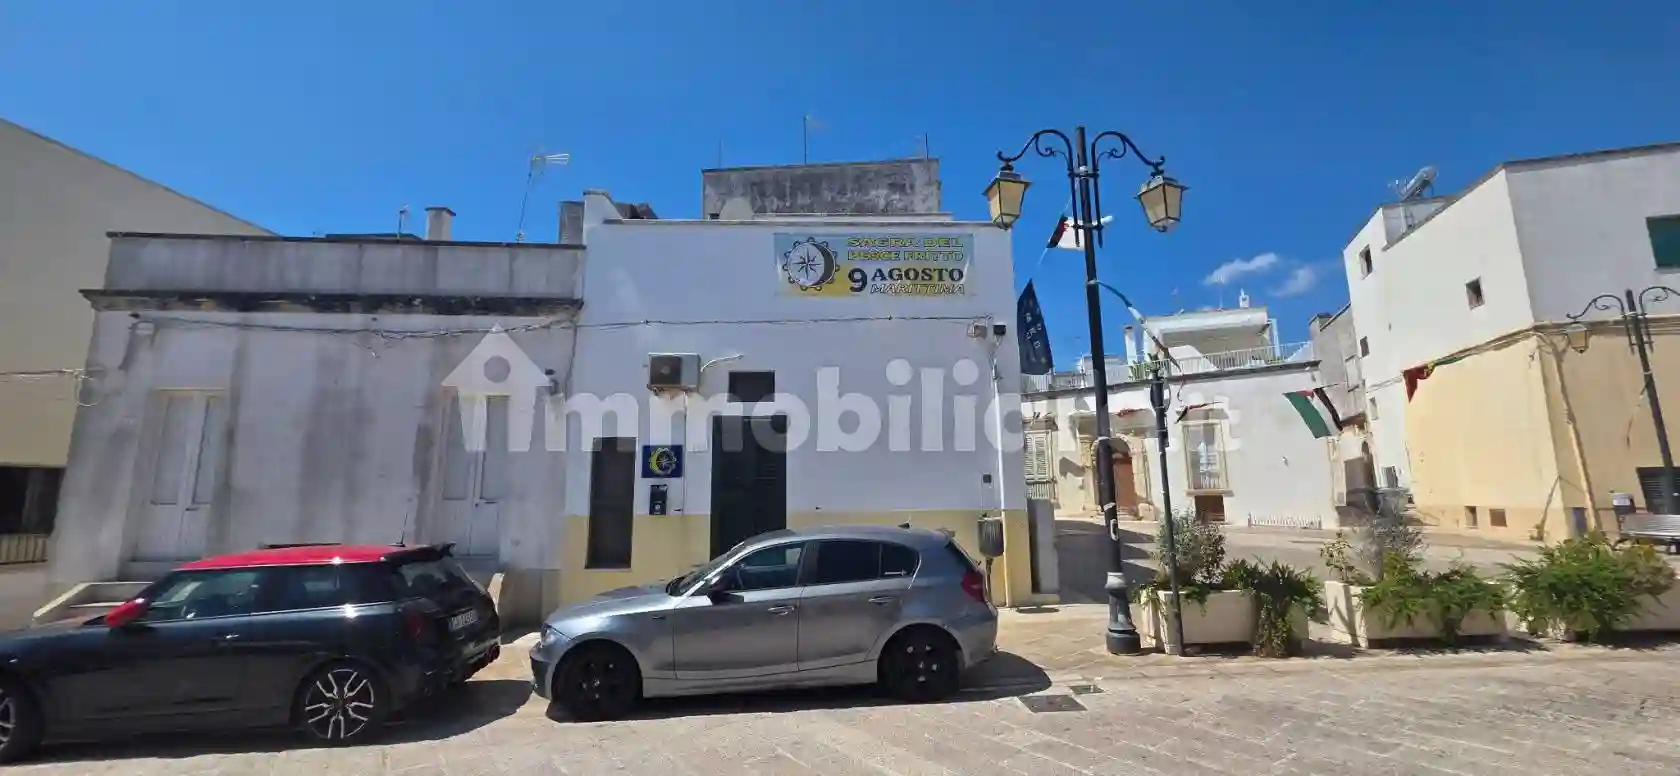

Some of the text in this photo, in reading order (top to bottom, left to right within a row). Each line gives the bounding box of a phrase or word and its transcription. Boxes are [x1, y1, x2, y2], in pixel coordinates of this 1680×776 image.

[848, 237, 964, 248] SAGRA DEL
[847, 250, 965, 261] PESCE FRITTO
[848, 267, 964, 293] 9 AGOSTO
[869, 283, 966, 294] MARITTIMA
